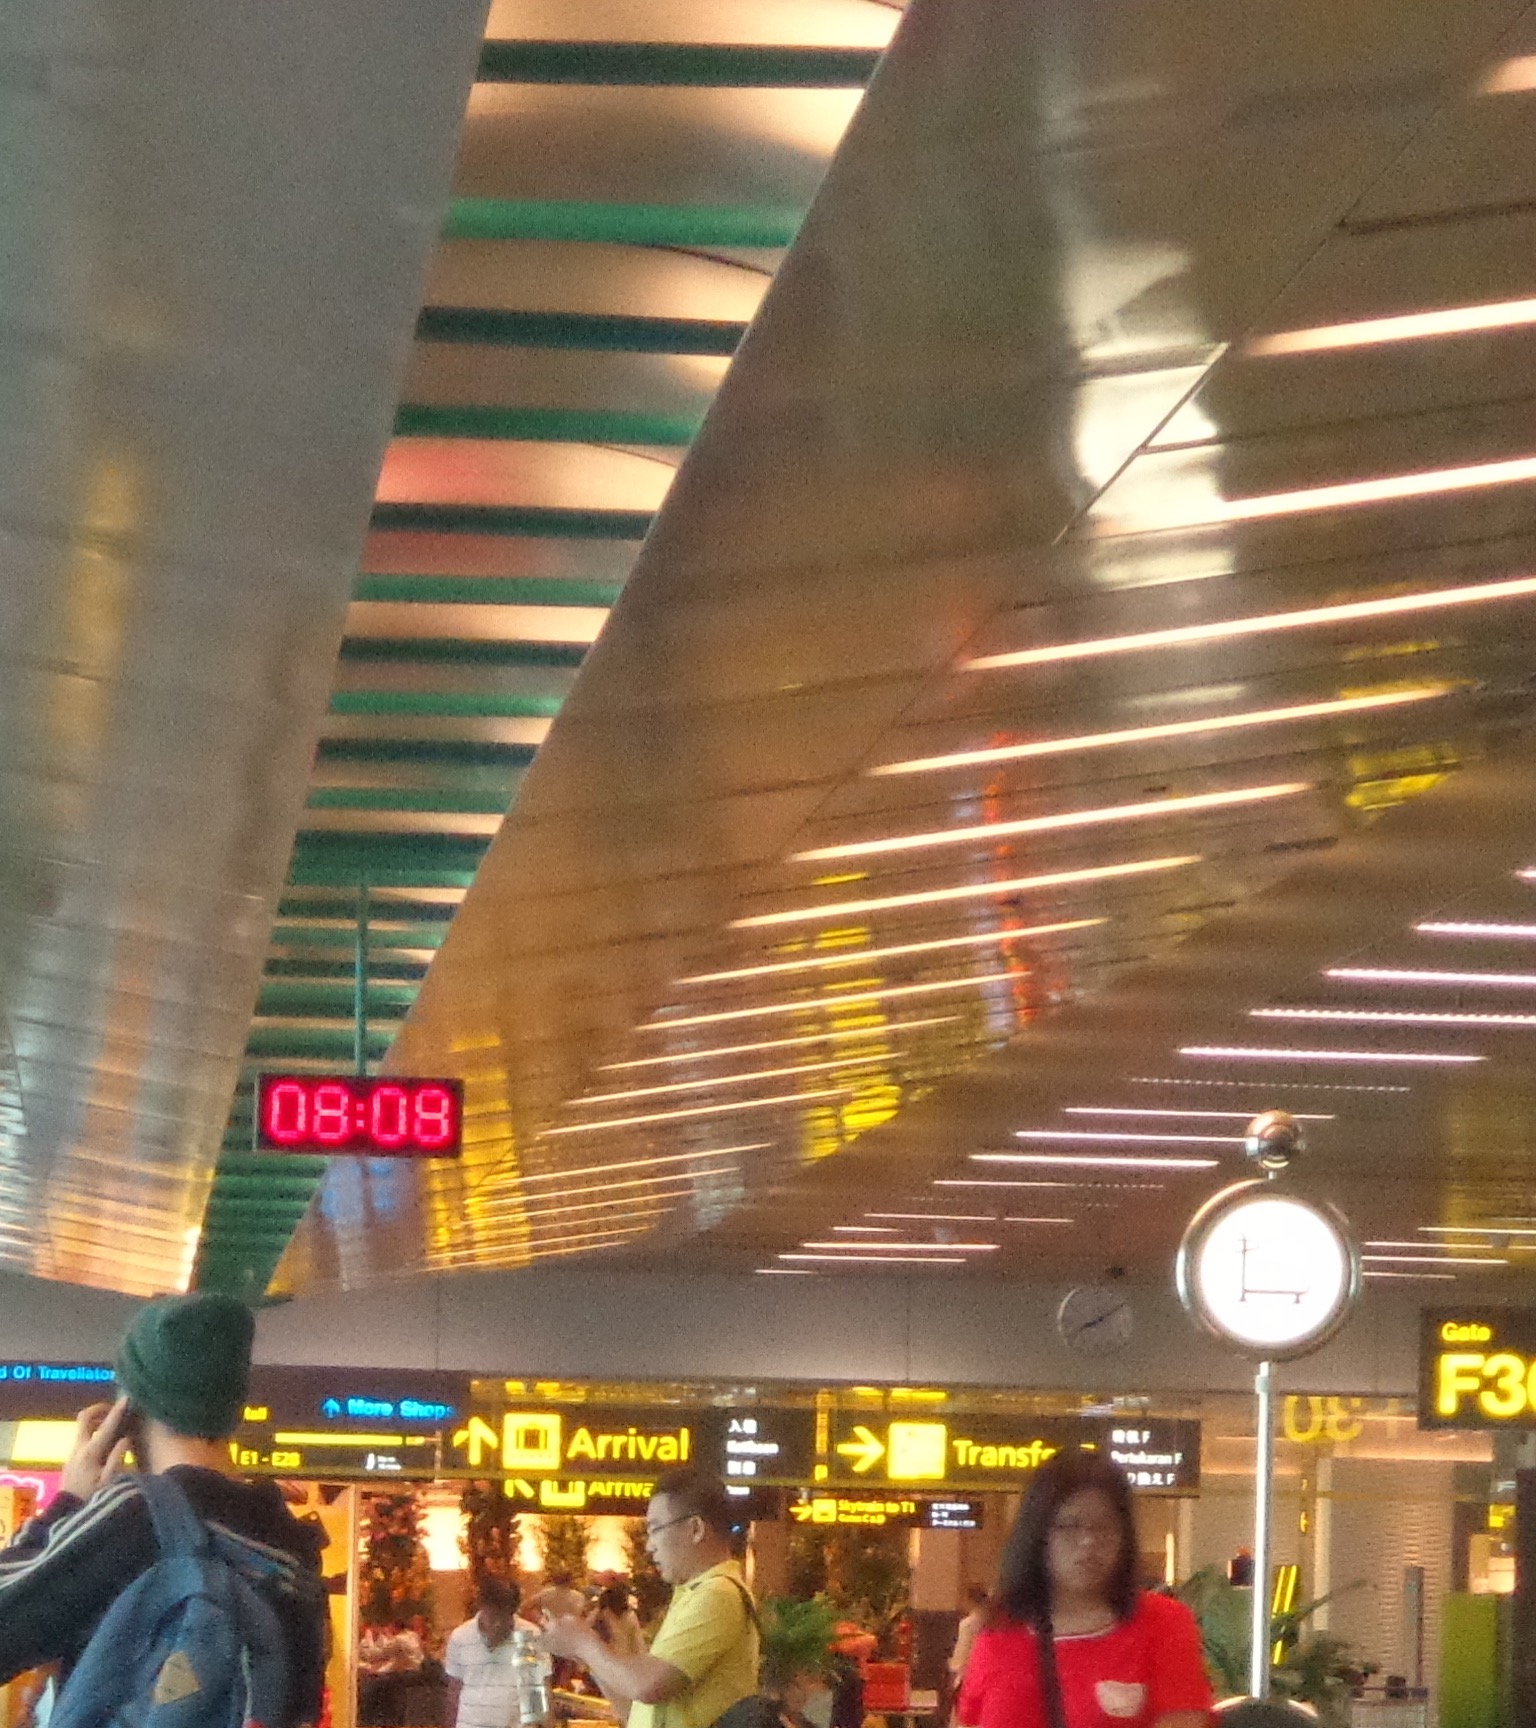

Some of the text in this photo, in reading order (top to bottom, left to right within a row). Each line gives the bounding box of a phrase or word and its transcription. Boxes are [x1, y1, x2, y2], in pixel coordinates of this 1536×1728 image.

[271, 1085, 449, 1142] 08:08
[1442, 1322, 1491, 1341] Gate
[14, 1365, 32, 1380] Of
[348, 1399, 393, 1417] More
[567, 1427, 690, 1461] Arrival
[952, 1440, 1058, 1467] Transfe
[588, 1482, 655, 1498] Arriva
[885, 1502, 900, 1513] to
